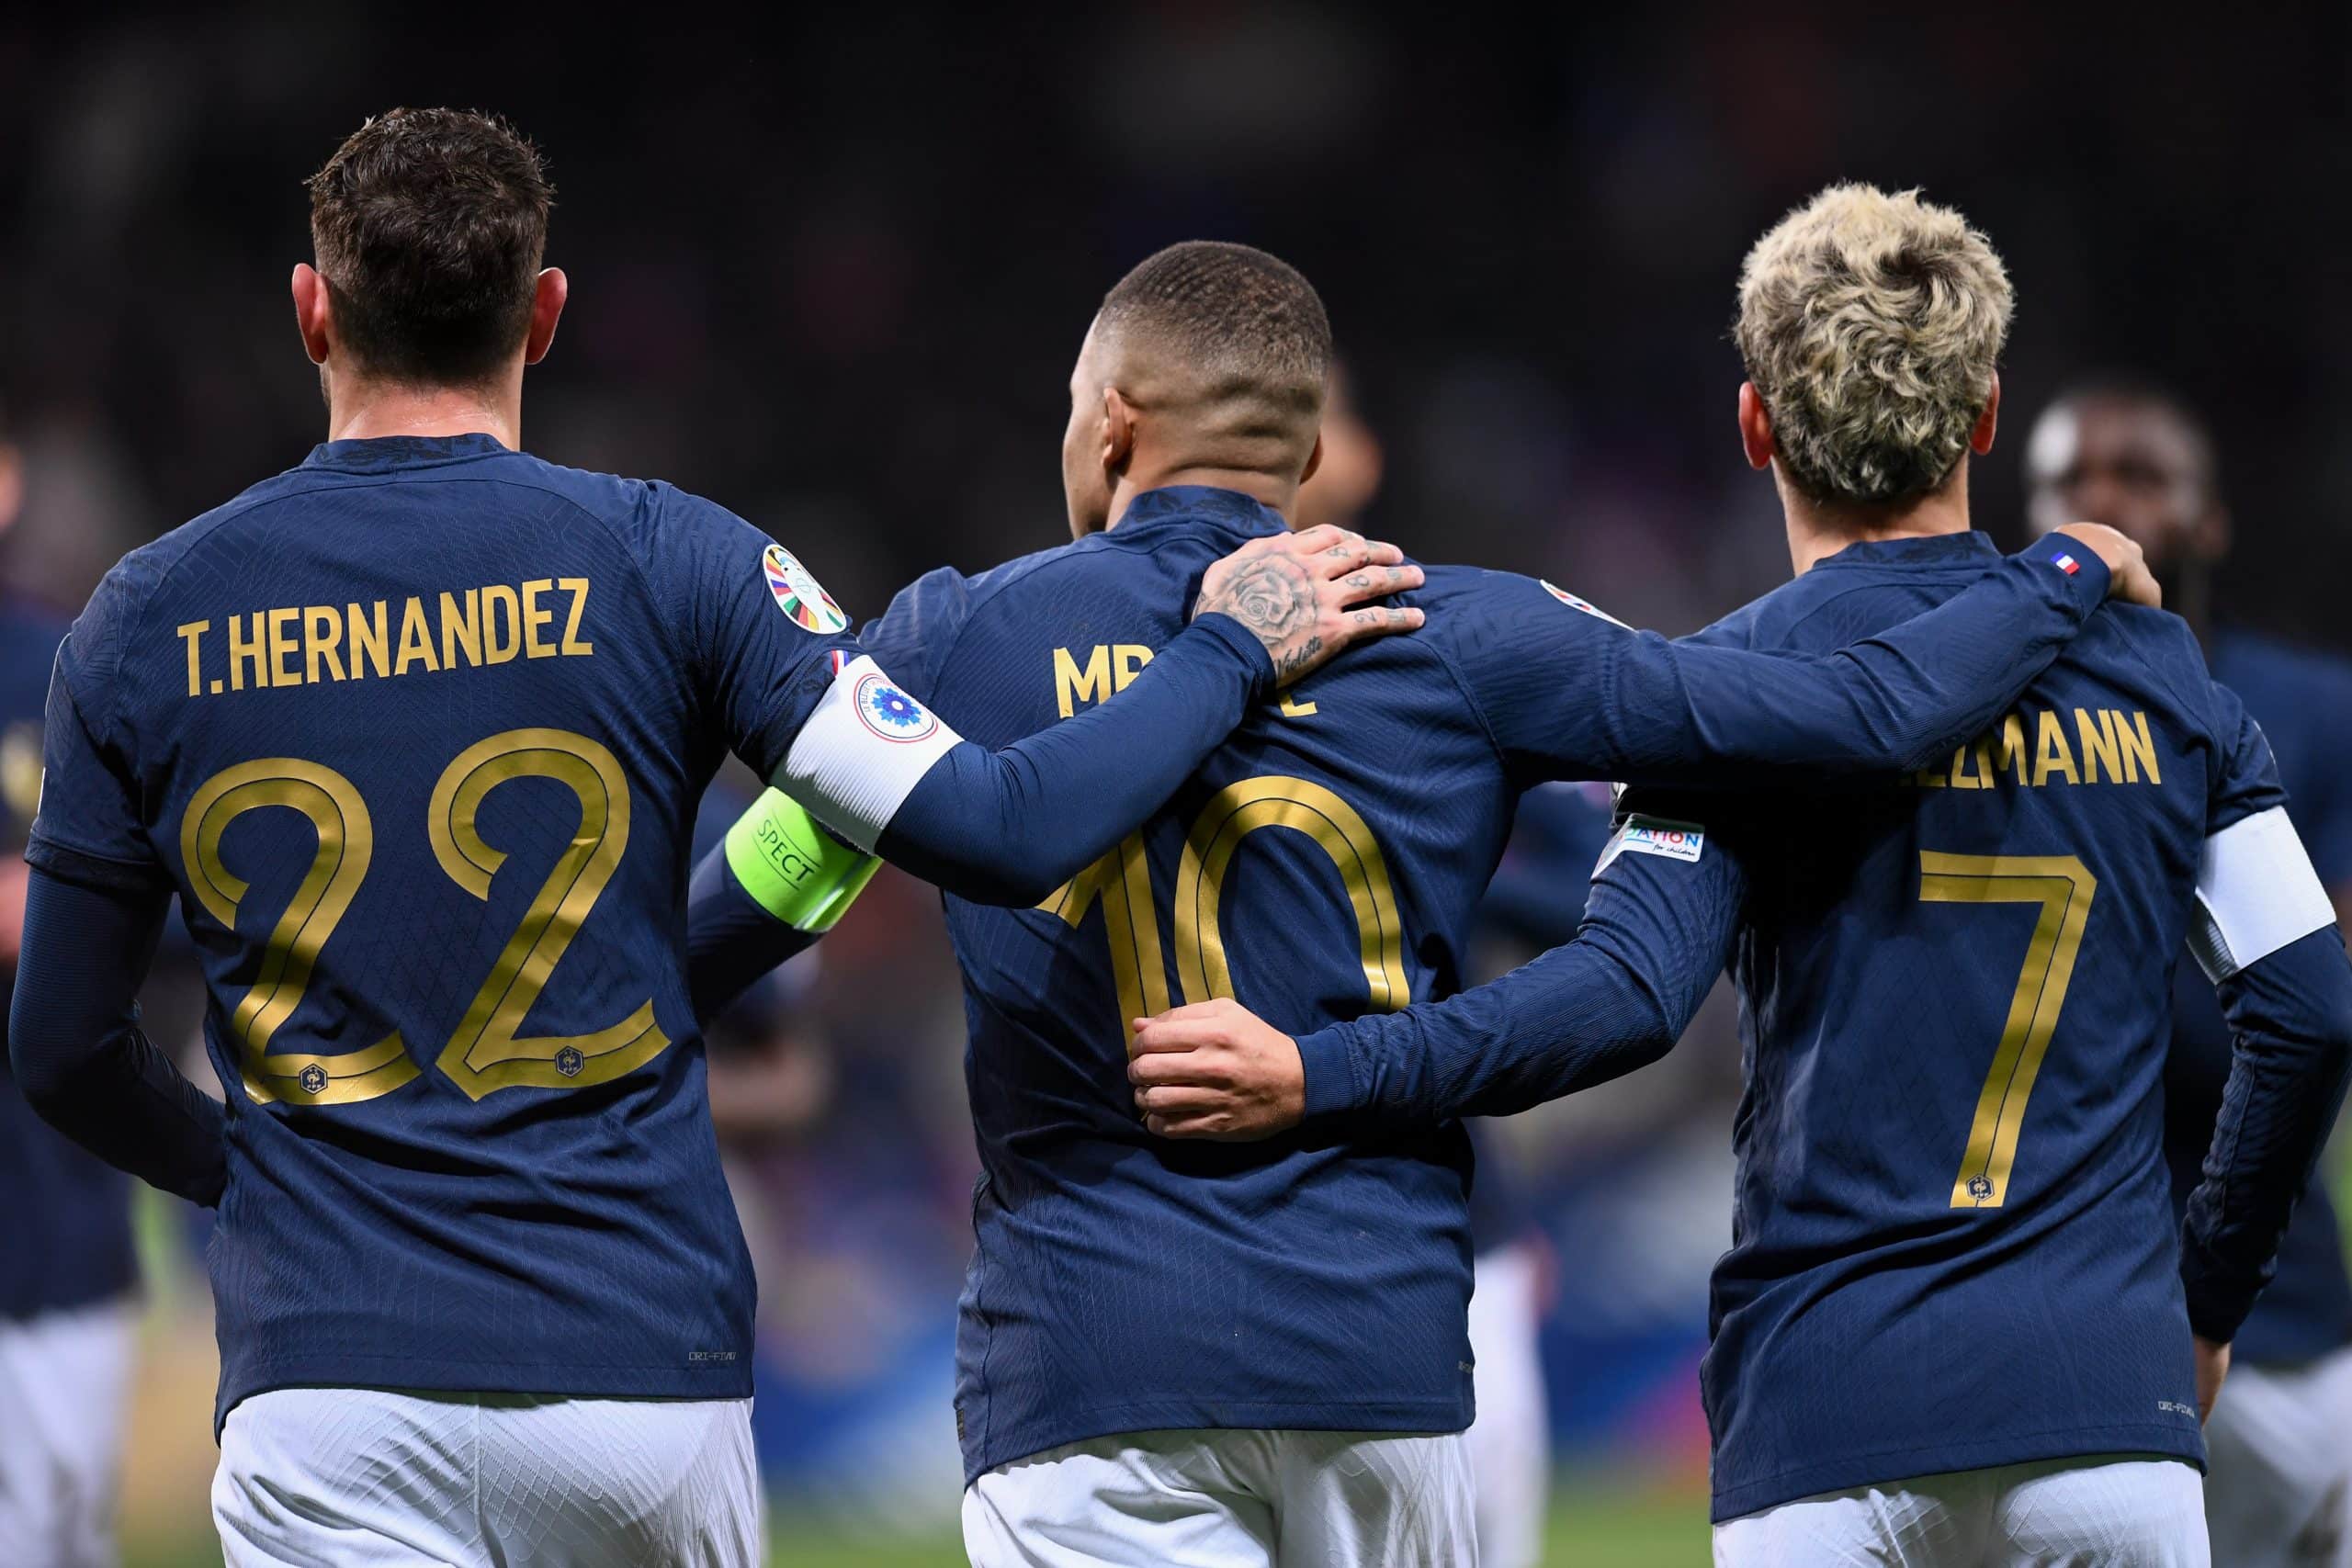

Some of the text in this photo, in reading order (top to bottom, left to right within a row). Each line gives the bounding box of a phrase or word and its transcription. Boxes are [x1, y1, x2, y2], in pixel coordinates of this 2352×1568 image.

[177, 578, 594, 697] T.HERNANDEZ
[180, 728, 673, 1106] 22
[1035, 775, 1411, 1055] 10
[1918, 850, 2098, 1209] 7
